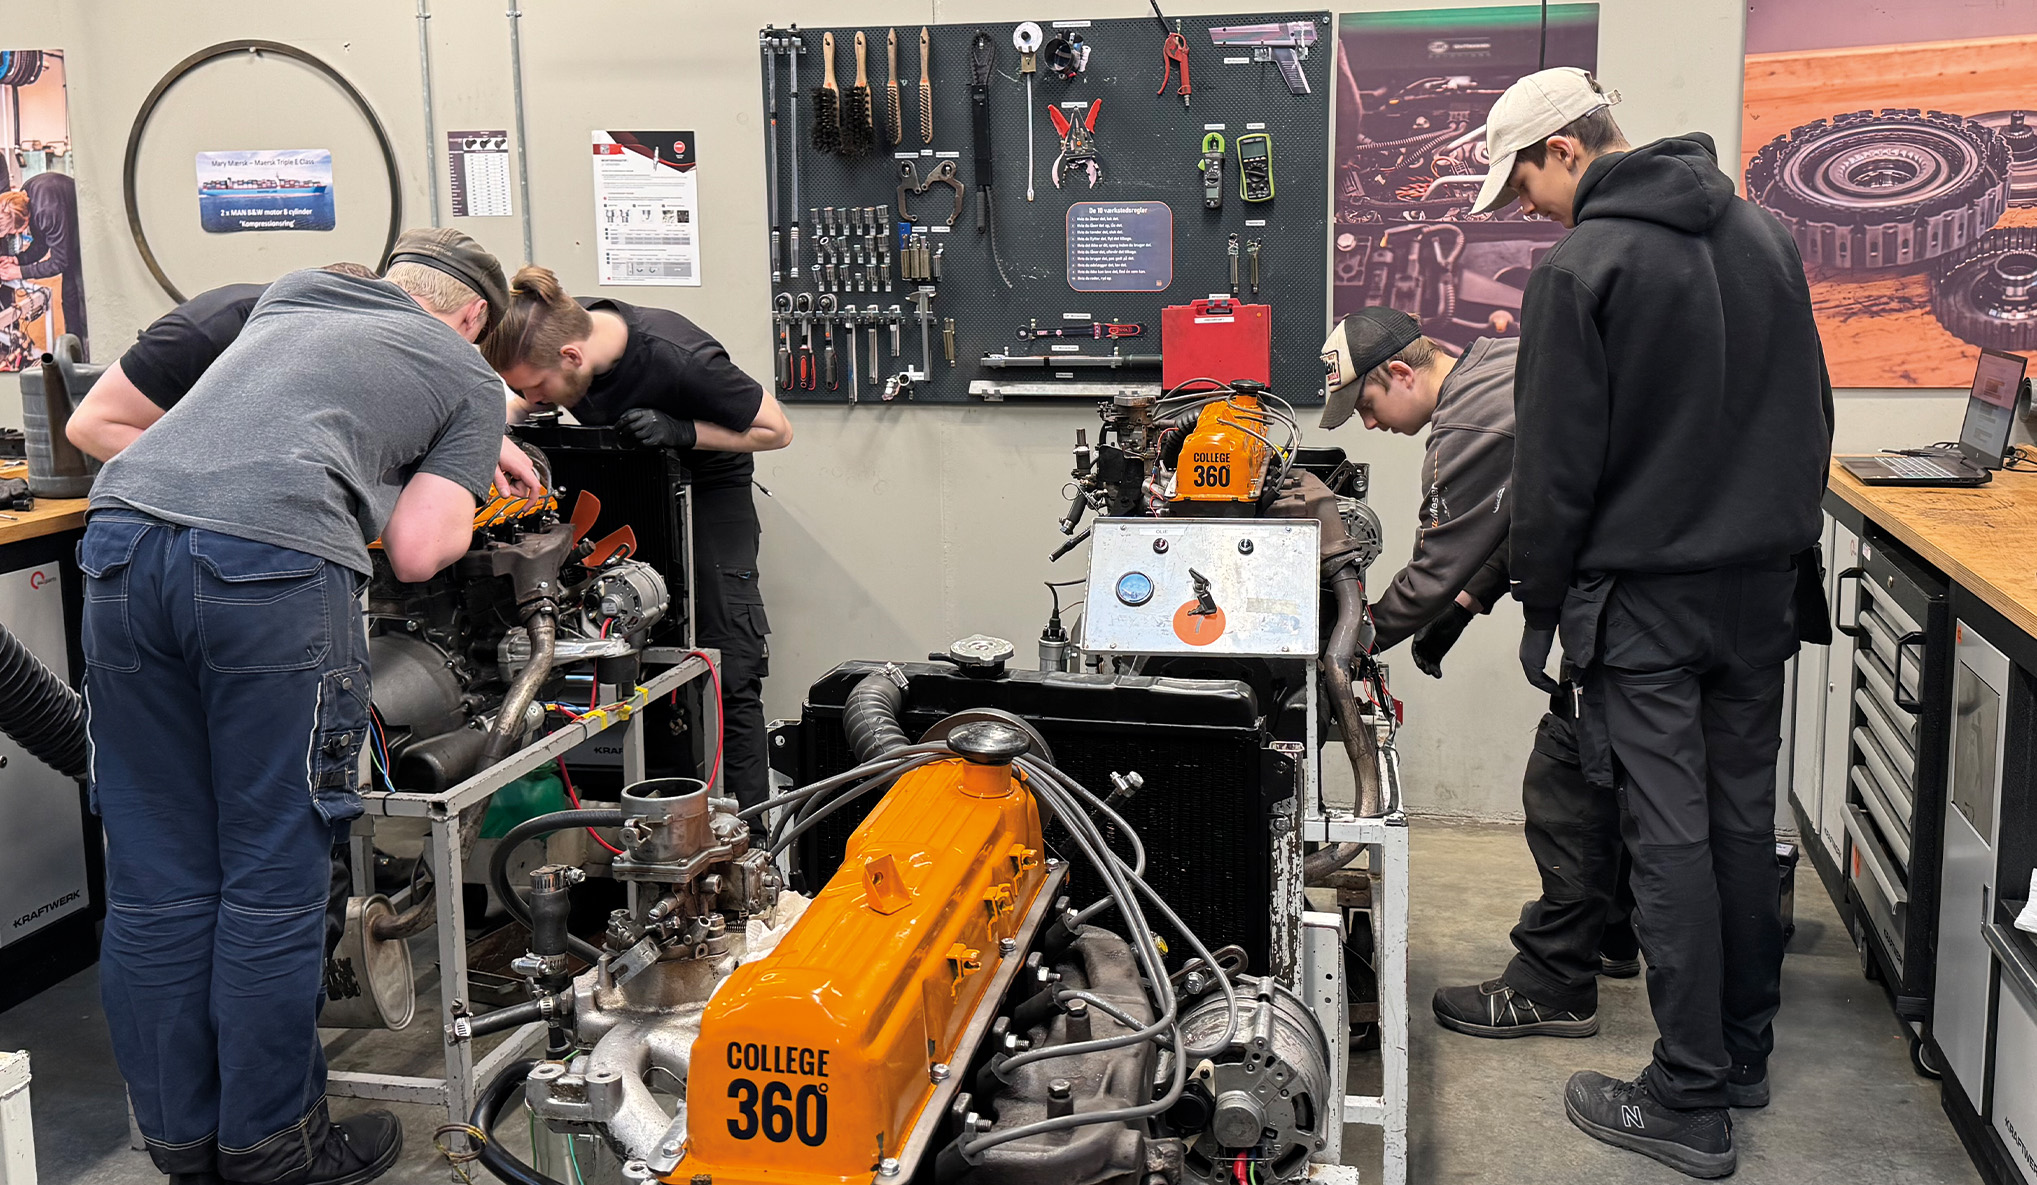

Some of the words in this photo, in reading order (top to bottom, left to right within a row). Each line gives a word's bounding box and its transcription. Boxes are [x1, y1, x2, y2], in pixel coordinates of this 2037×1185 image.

[211, 160, 227, 168] Mary
[228, 159, 248, 167] Mærsk
[277, 158, 294, 166] Triple
[299, 158, 315, 166] Class
[220, 209, 225, 217] 2
[230, 209, 247, 217] MAN
[264, 208, 283, 216] motor
[288, 208, 313, 217] cylinder
[1103, 206, 1148, 215] værkstedsregler
[1193, 452, 1231, 463] COLLEGE
[1193, 464, 1231, 488] 360°
[12, 889, 81, 929] KRAFTWERK
[726, 1041, 830, 1078] COLLEGE
[726, 1077, 829, 1148] 360°
[1621, 1104, 1645, 1129] N
